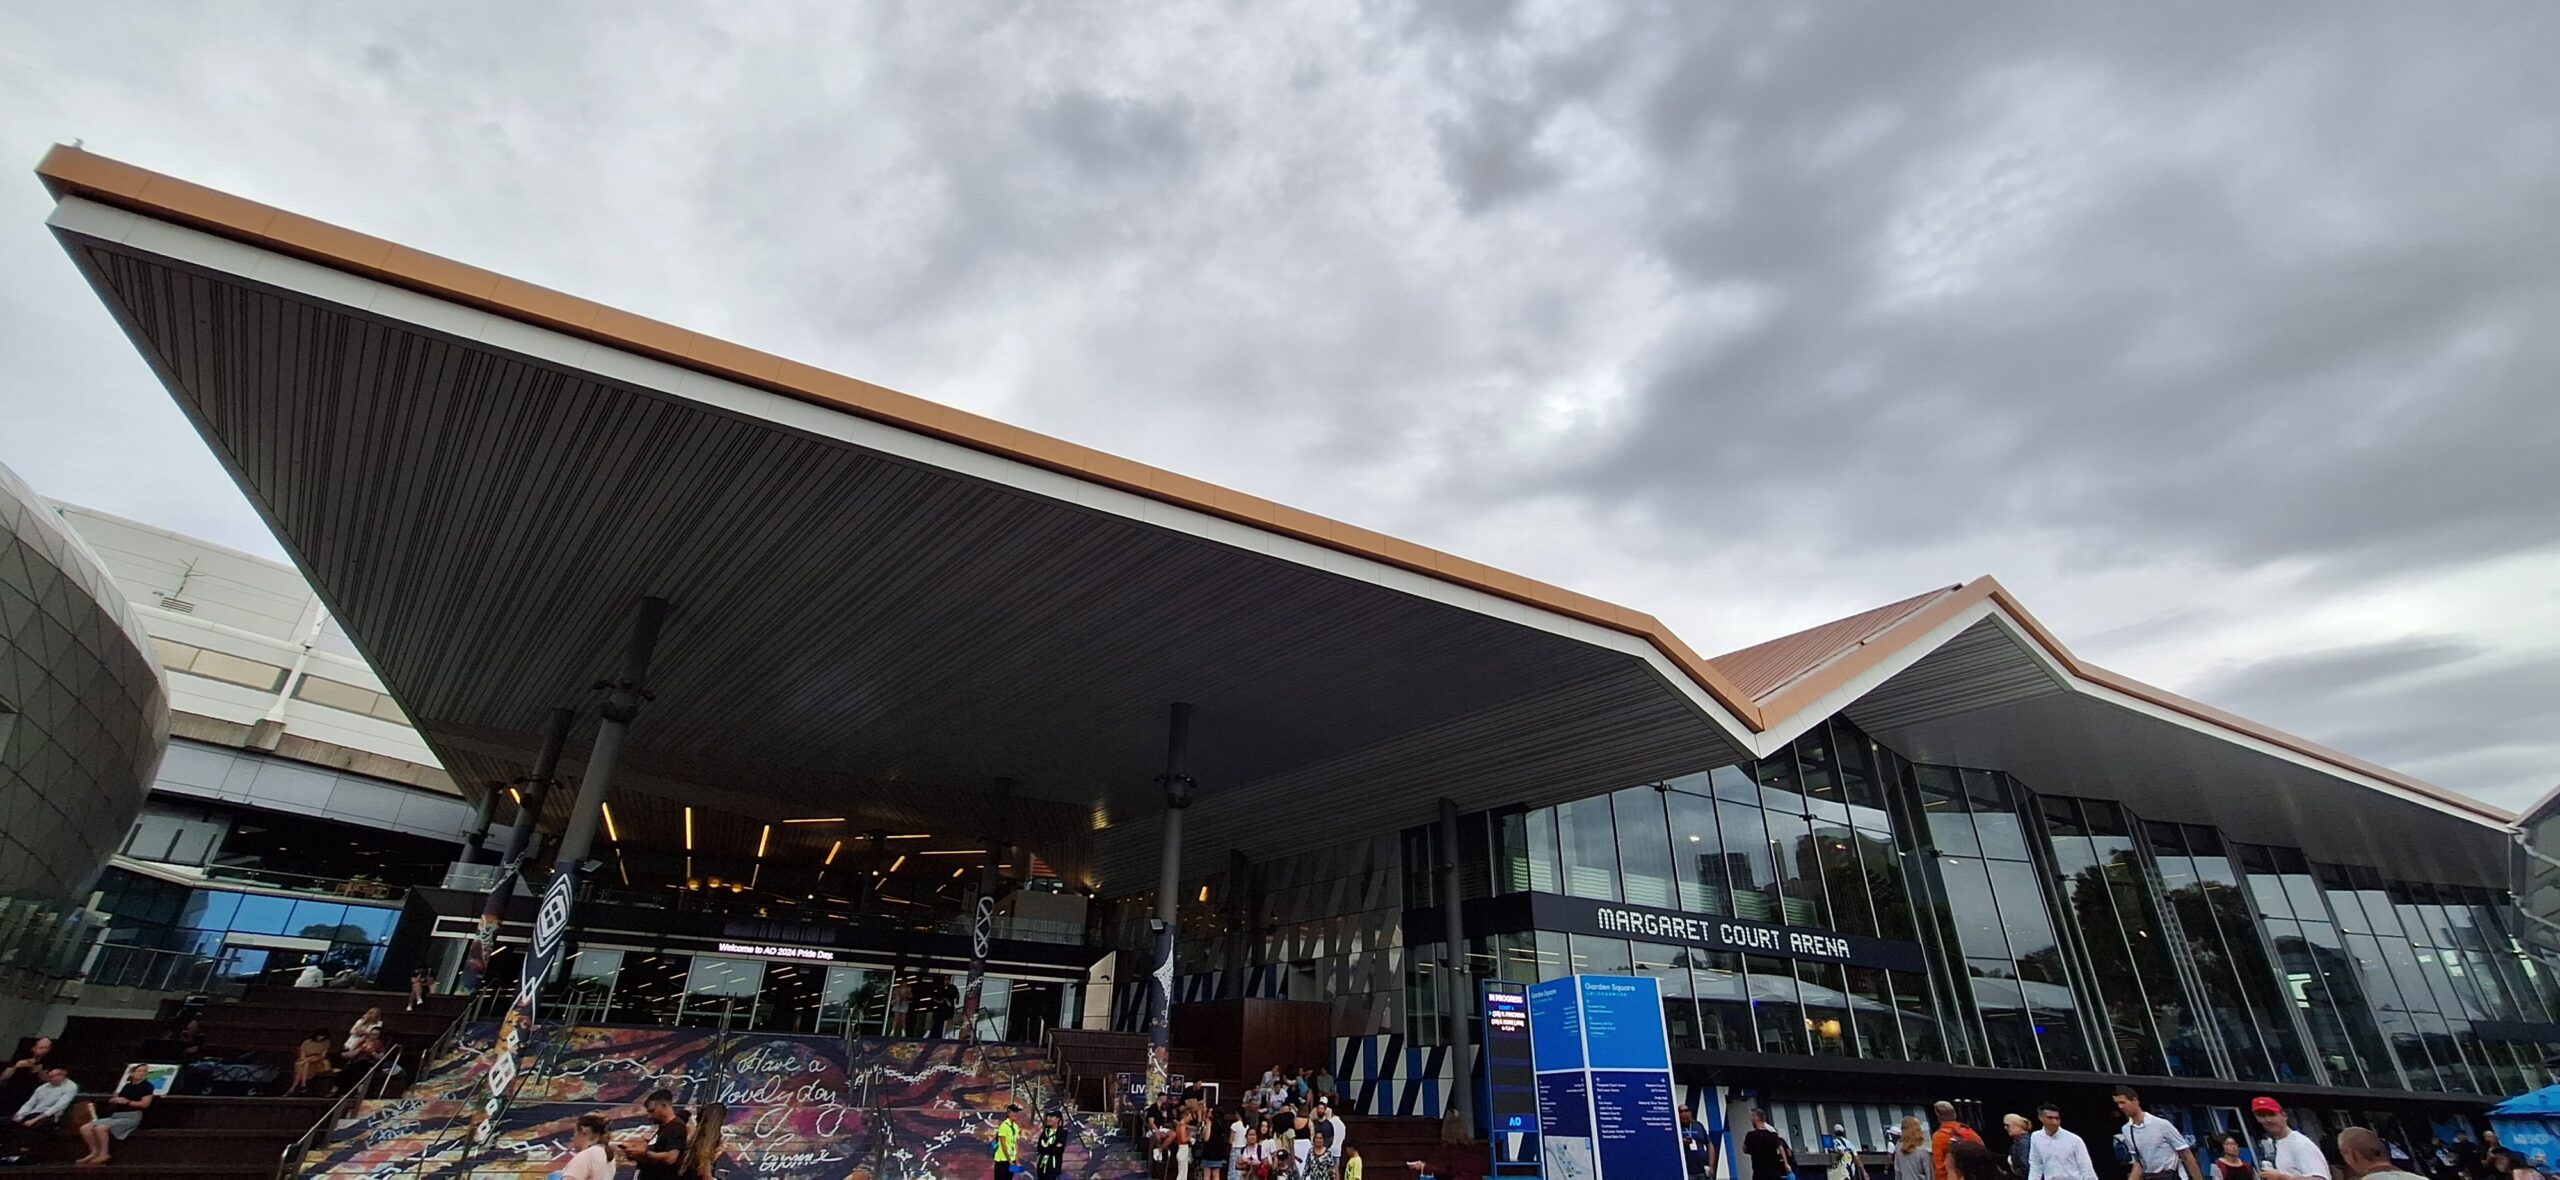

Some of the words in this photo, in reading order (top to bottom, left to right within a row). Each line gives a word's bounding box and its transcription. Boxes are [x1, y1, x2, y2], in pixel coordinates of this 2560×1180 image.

[1598, 908, 1710, 942] MARGARET
[1720, 923, 1781, 951] COURT
[1789, 933, 1851, 959] ARENA
[719, 942, 754, 955] Welcome
[755, 946, 764, 954] to
[763, 946, 777, 956] AO
[777, 947, 797, 957] 2024
[797, 949, 817, 958] Pride
[1584, 982, 1611, 991] Garden
[1611, 983, 1636, 993] Square
[737, 1048, 801, 1074] Have
[808, 1060, 828, 1073] a
[718, 1075, 794, 1138] lovely
[796, 1079, 847, 1137] day
